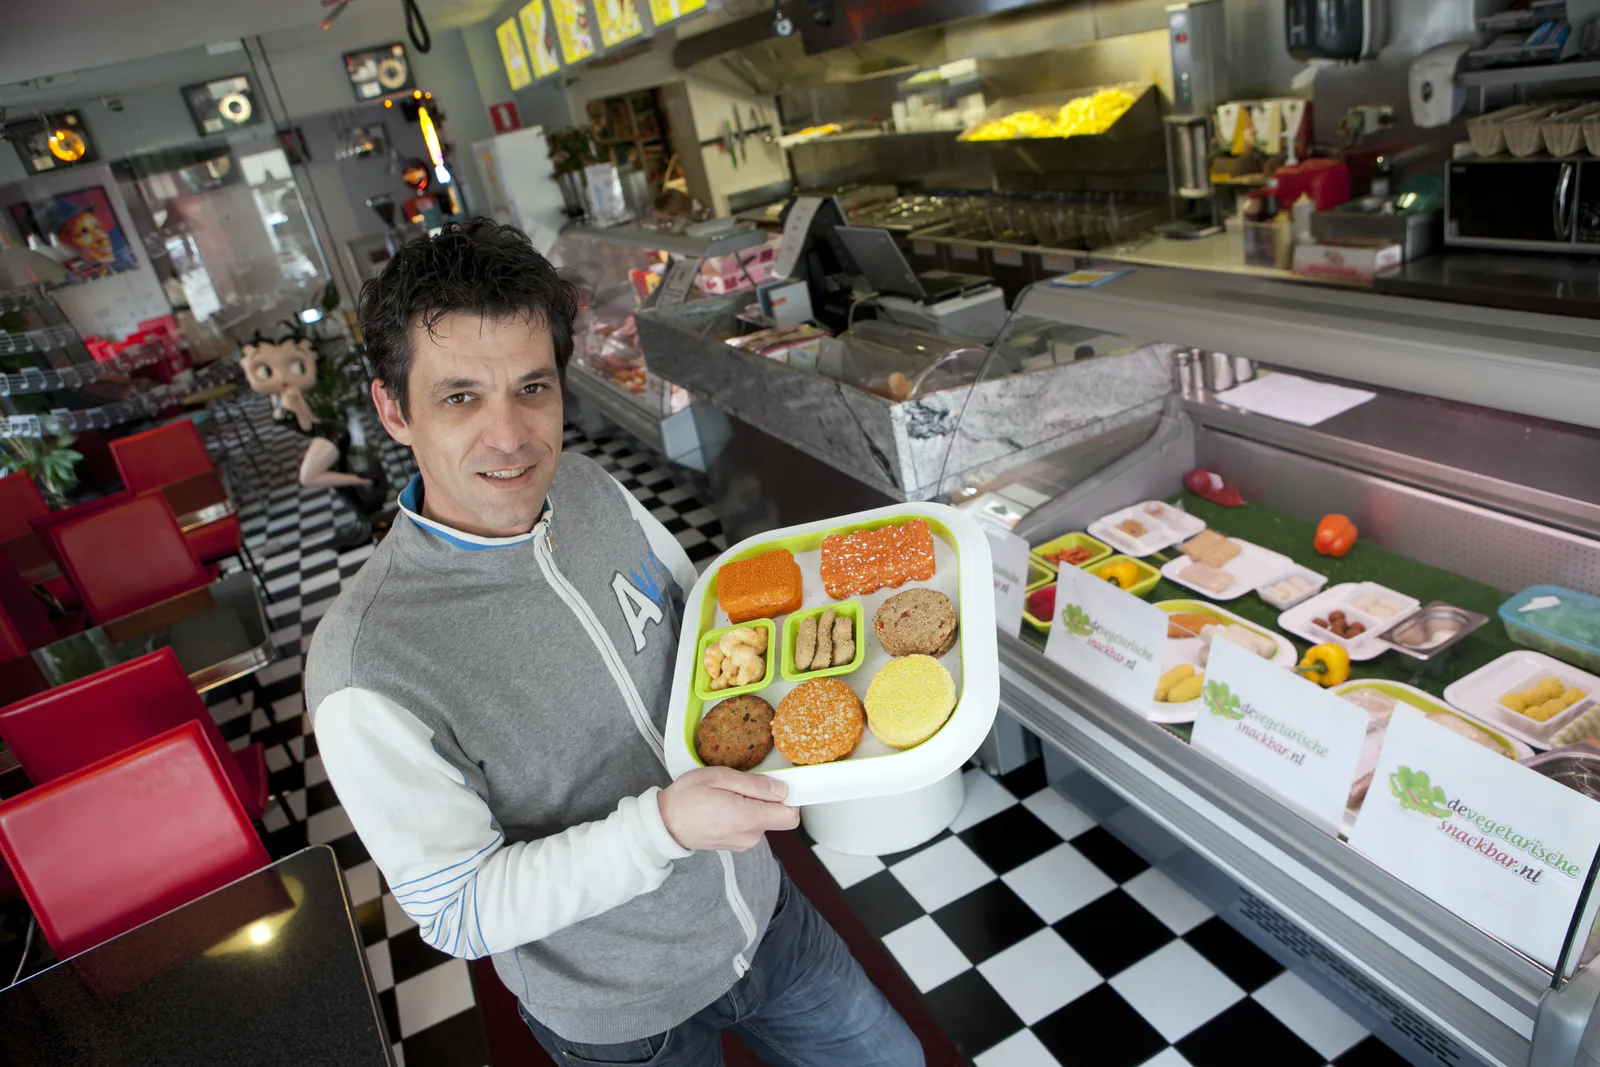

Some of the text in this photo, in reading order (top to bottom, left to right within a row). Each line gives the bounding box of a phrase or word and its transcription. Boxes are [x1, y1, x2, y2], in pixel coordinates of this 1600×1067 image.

[1237, 721, 1306, 766] snackbar.nl
[1241, 703, 1328, 757] devegetarische
[1437, 819, 1545, 884] snackbar.nl
[1446, 799, 1580, 877] devegetarische
